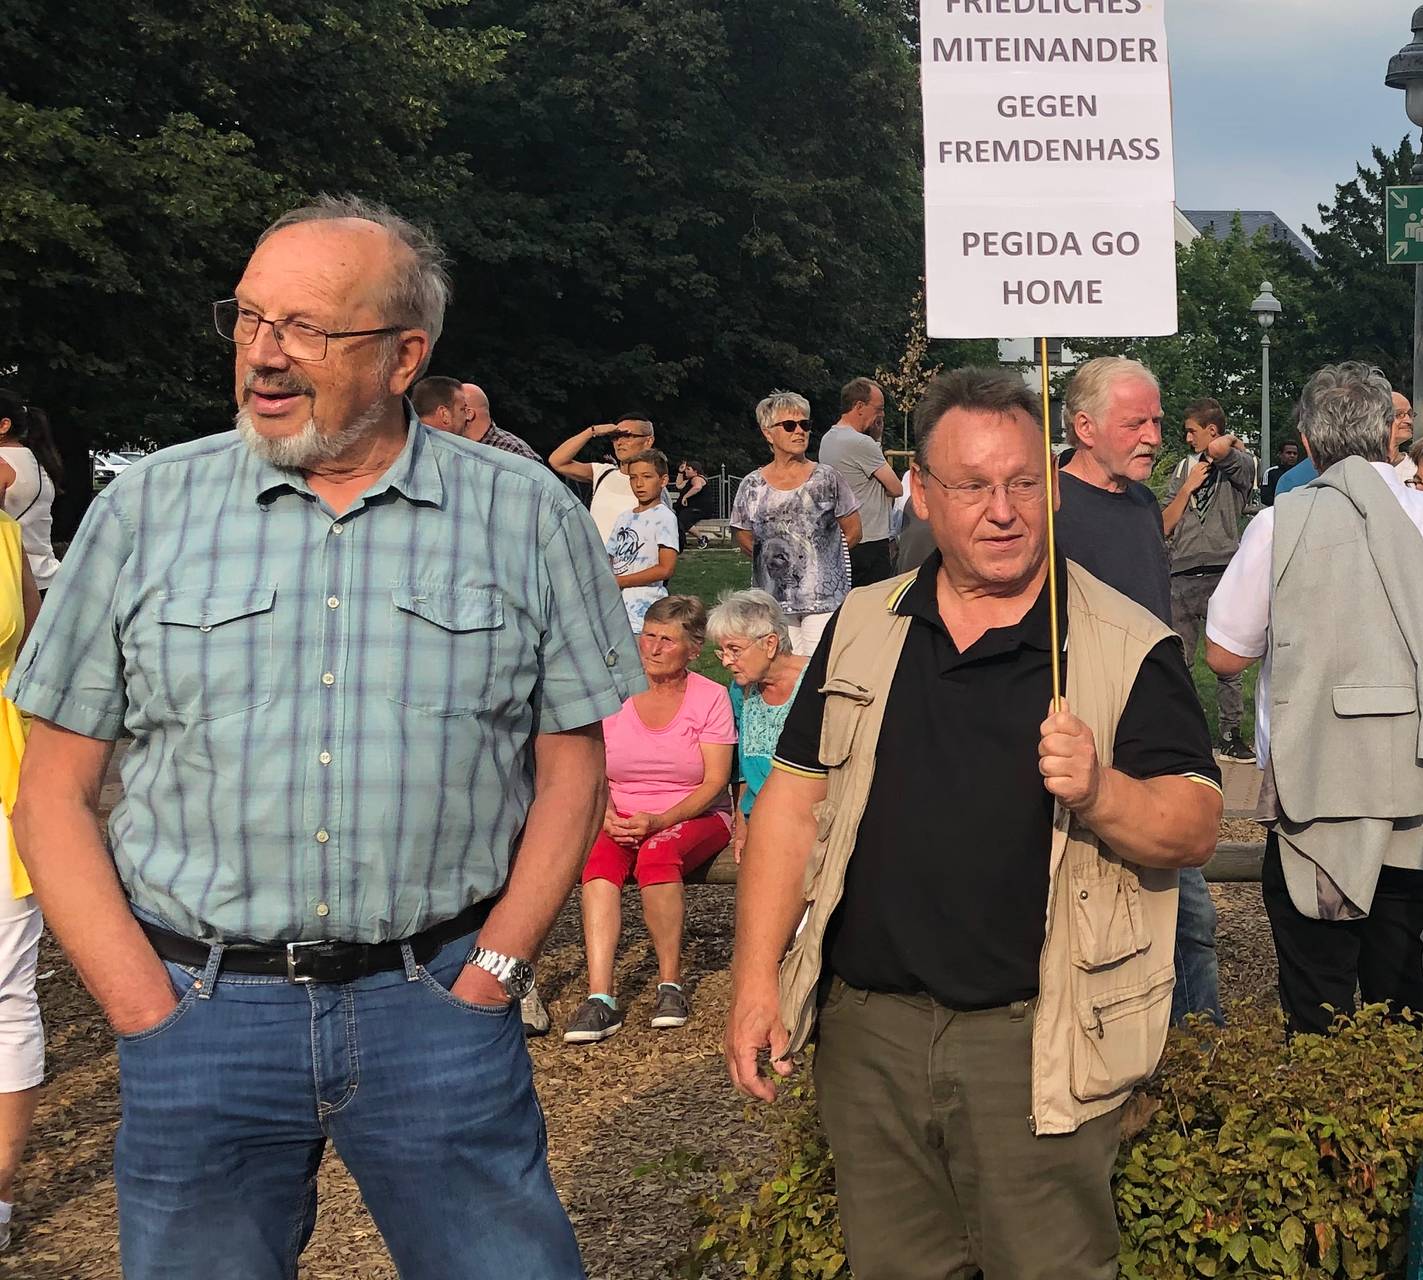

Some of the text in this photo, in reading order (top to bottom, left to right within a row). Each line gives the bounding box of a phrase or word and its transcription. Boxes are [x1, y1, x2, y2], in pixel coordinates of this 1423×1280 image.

[932, 37, 1158, 62] MITEINANDER
[997, 95, 1097, 118] GEGEN
[939, 137, 1160, 163] FREMDENHASS
[962, 231, 1140, 257] PEGIDA GO
[1002, 280, 1103, 305] HOME
